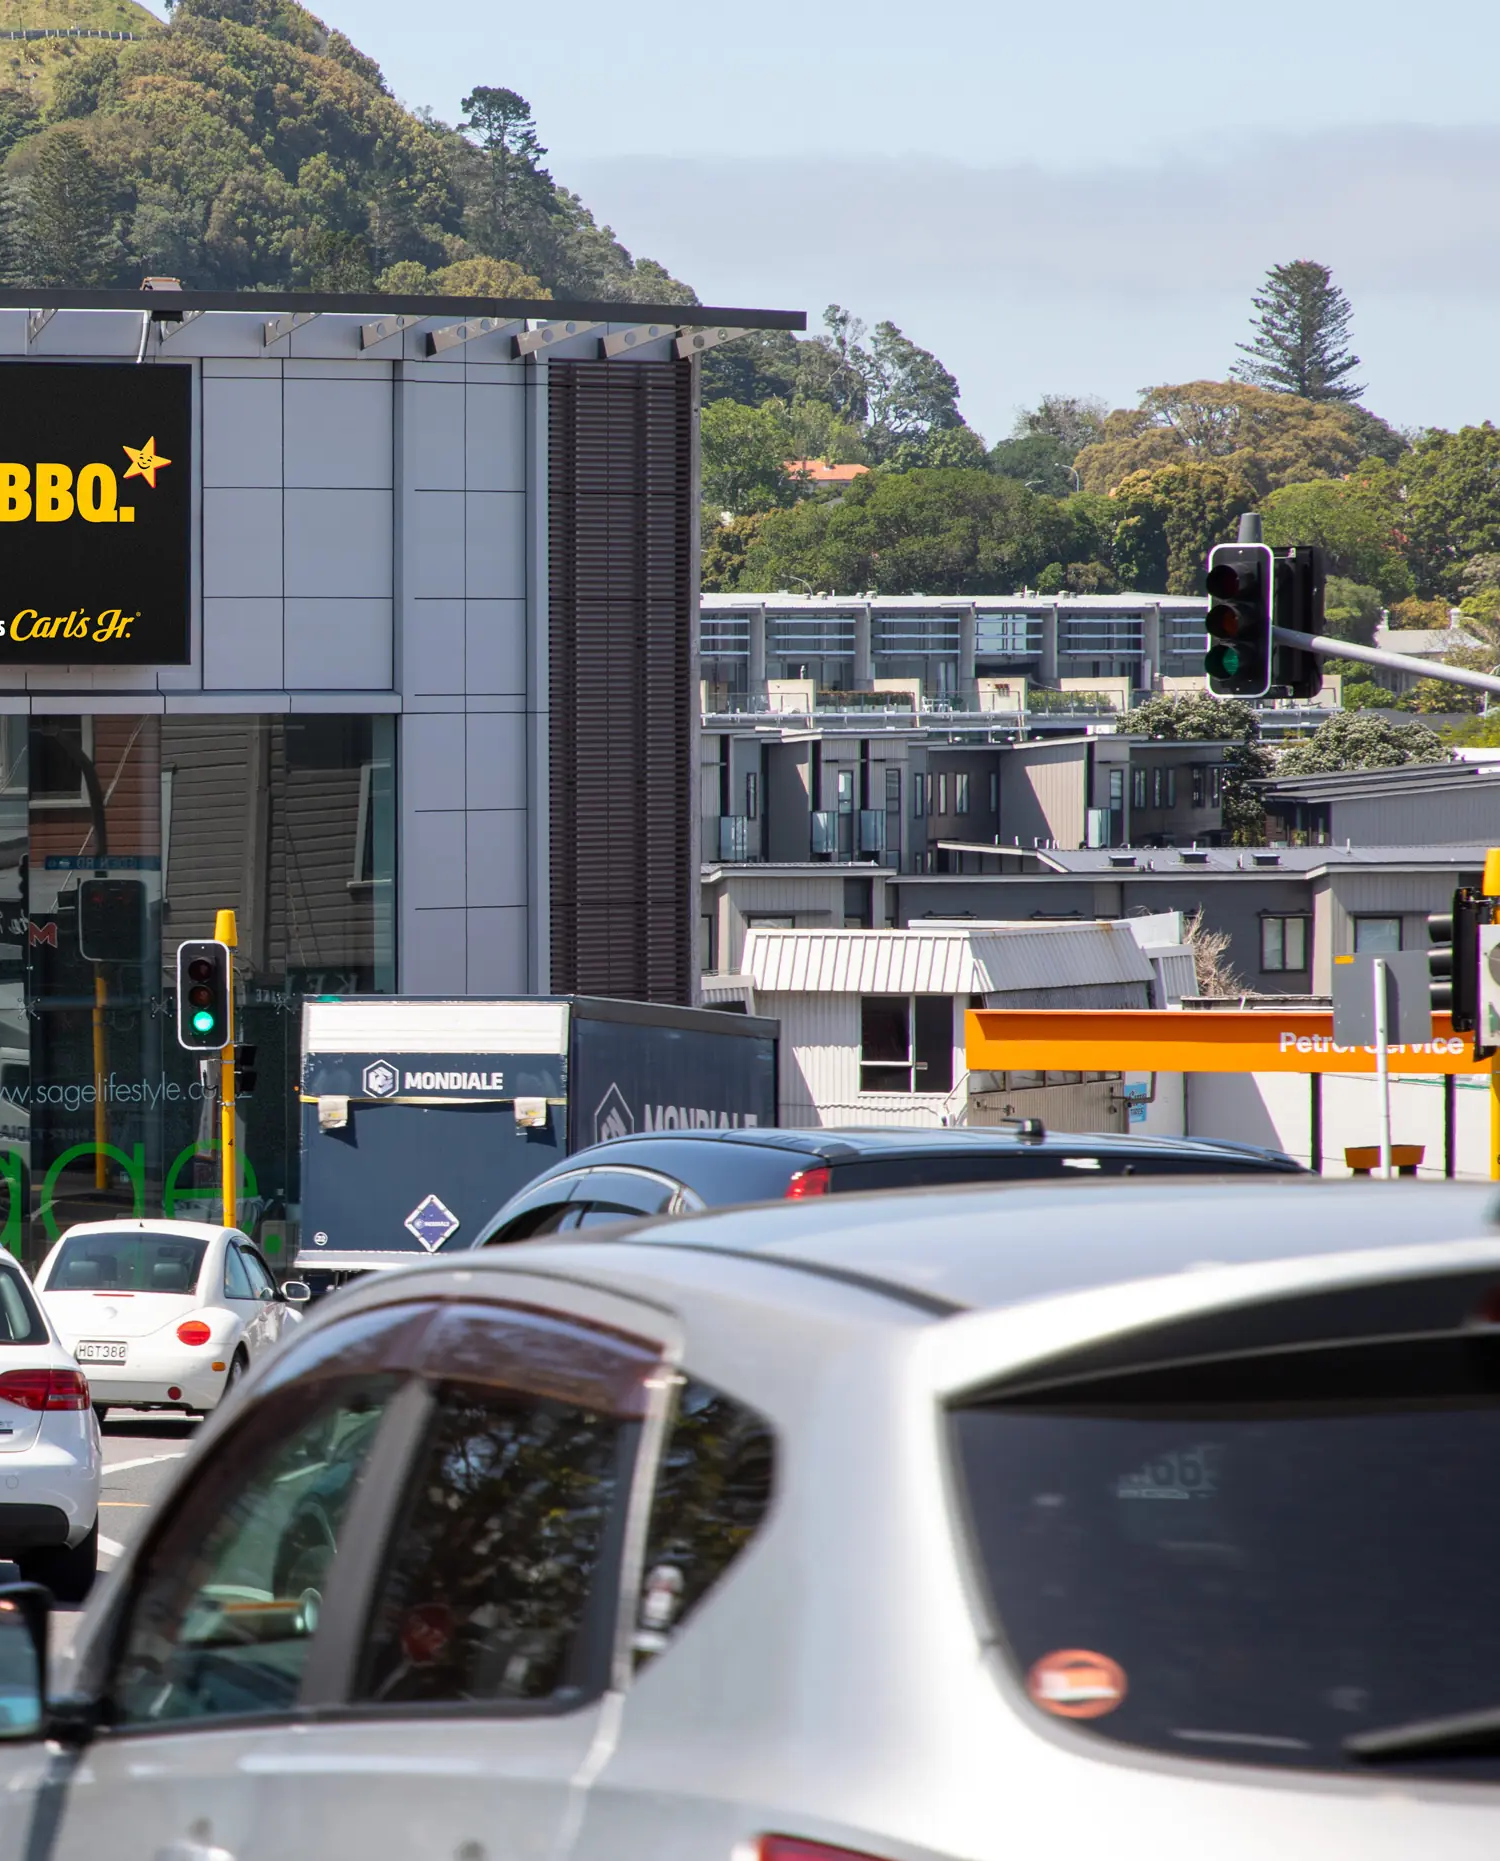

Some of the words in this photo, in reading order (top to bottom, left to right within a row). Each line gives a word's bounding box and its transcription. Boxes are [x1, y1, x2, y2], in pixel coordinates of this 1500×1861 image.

[9, 608, 90, 642] Carl's
[92, 609, 132, 643] Jr.
[404, 1072, 504, 1090] MONDIALE
